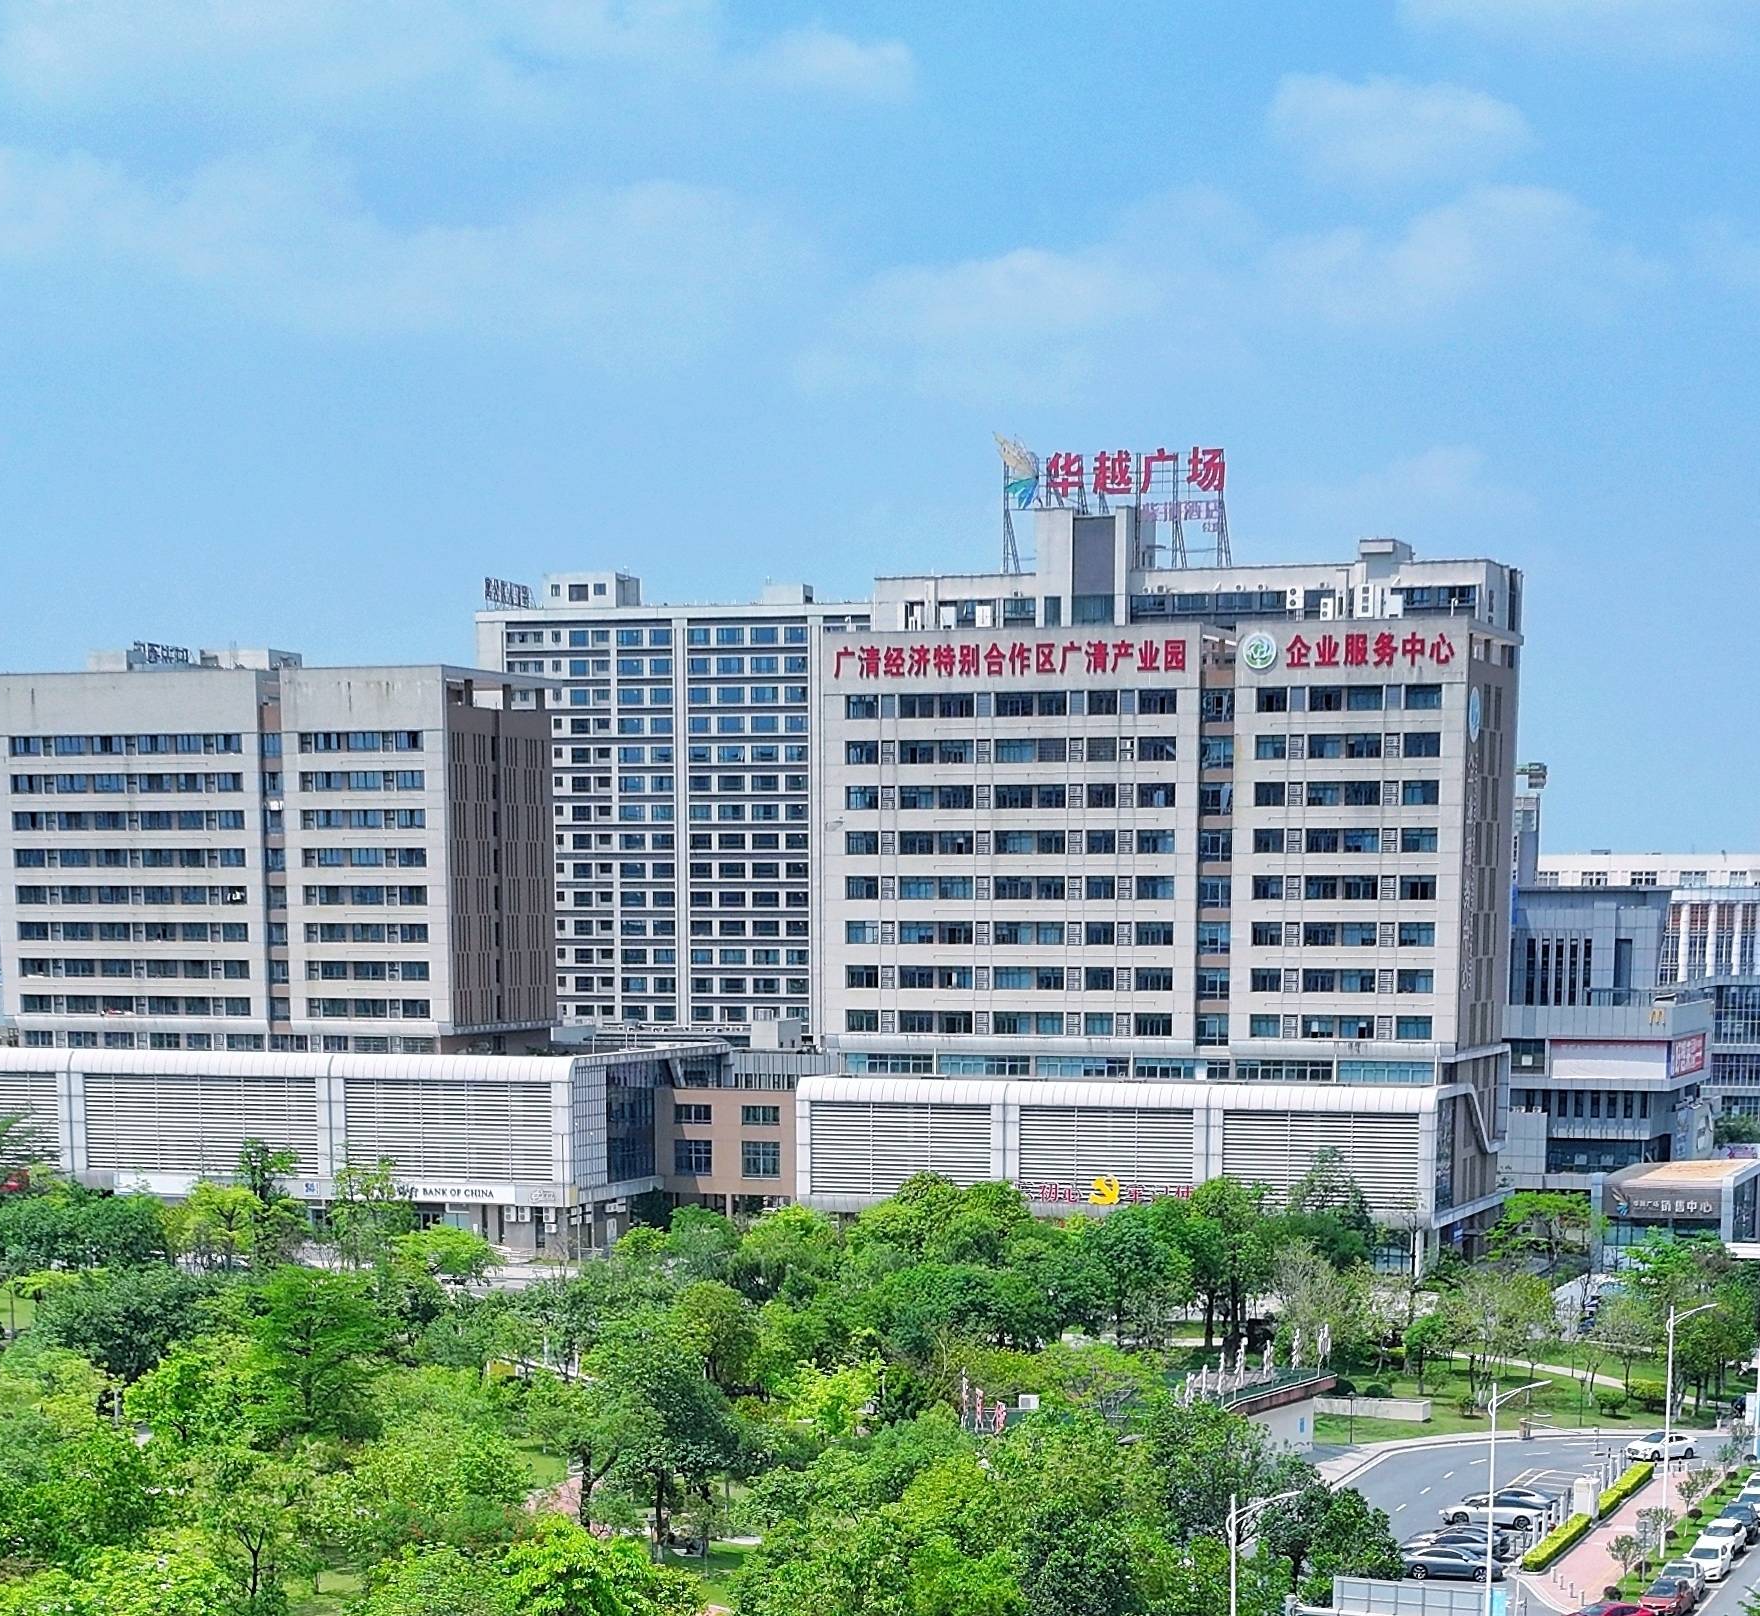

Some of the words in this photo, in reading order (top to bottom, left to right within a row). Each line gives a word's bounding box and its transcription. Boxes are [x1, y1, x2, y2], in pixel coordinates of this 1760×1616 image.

[1046, 446, 1226, 497] 华越广场
[834, 639, 1187, 679] 广清经济特别合作区广清产业园
[1286, 631, 1455, 667] 企业服务中心
[422, 1187, 447, 1197] BANK
[449, 1188, 461, 1197] OF
[463, 1188, 495, 1199] CHINA
